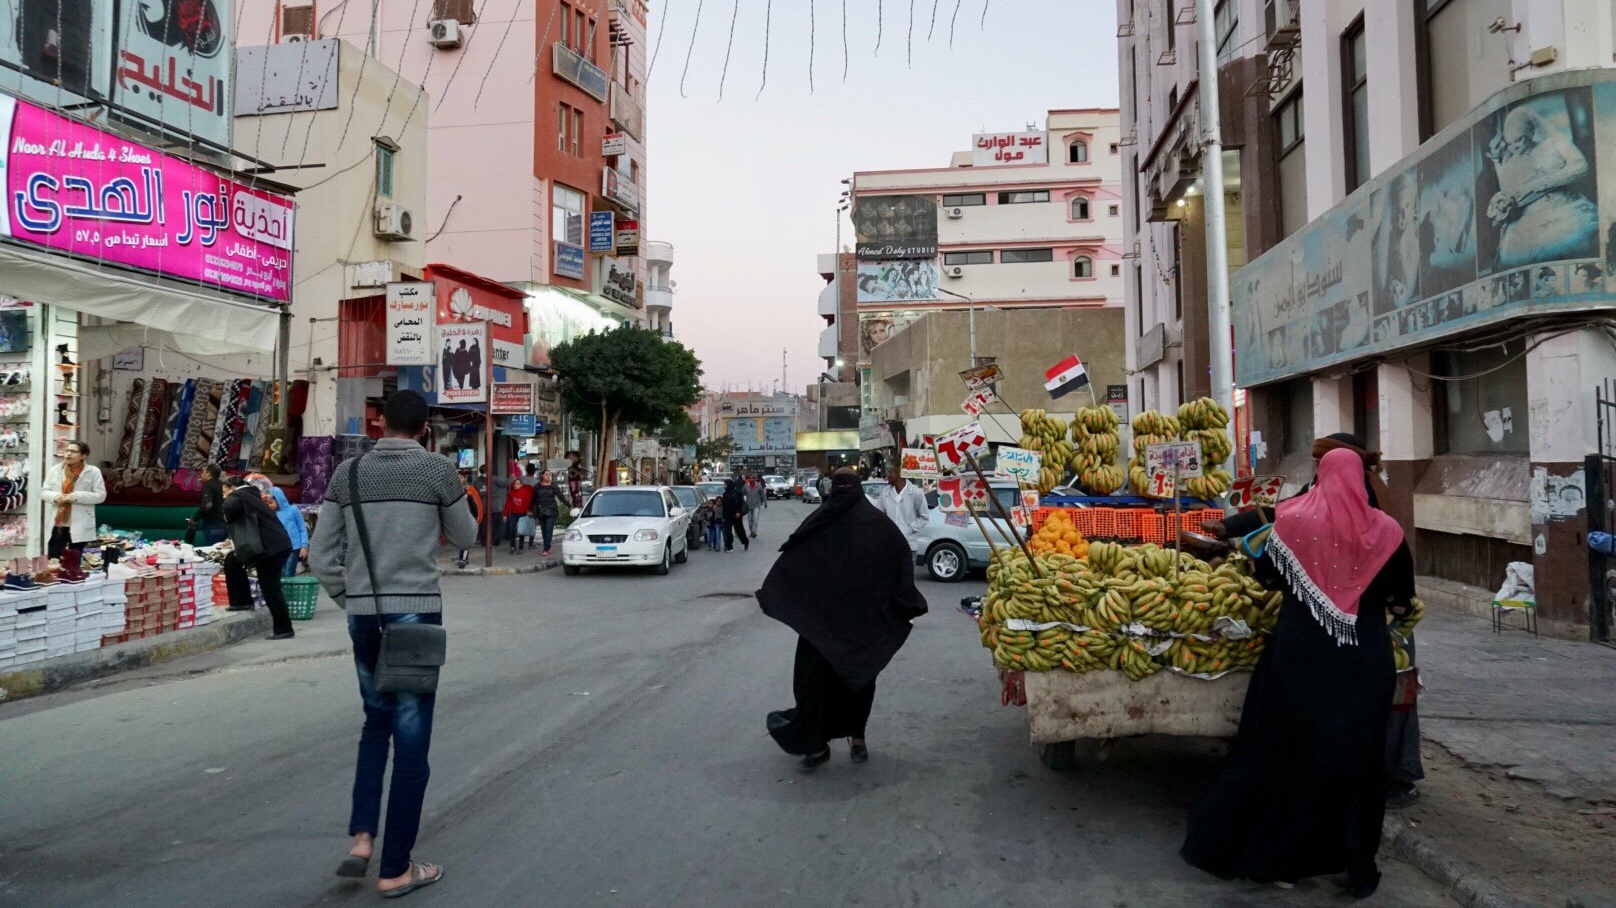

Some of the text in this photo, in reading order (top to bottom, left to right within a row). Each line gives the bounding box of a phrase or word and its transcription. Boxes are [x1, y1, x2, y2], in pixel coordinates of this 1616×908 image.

[118, 49, 224, 116] الخليج
[977, 134, 1042, 150] عبد الوارث
[13, 136, 152, 165] Noor Al Huda 4 Shoes
[995, 149, 1024, 163] مول
[15, 166, 230, 246] نور الهدى
[234, 199, 288, 240] أحذية
[105, 235, 122, 247] من
[123, 230, 140, 249] تبدأ
[141, 232, 168, 249] أسعار
[226, 243, 287, 270] حريمى أطفالى
[858, 246, 884, 256] Ahmed
[907, 246, 935, 254] STUDIO
[399, 288, 418, 298] مكتب
[390, 300, 428, 311] نور مبارك
[394, 318, 423, 328] المحامى
[397, 332, 422, 344] بالنقض
[441, 329, 461, 338] الخليج
[736, 403, 785, 415] سنتر ماهر
[748, 443, 796, 451] سنتر ماهر
